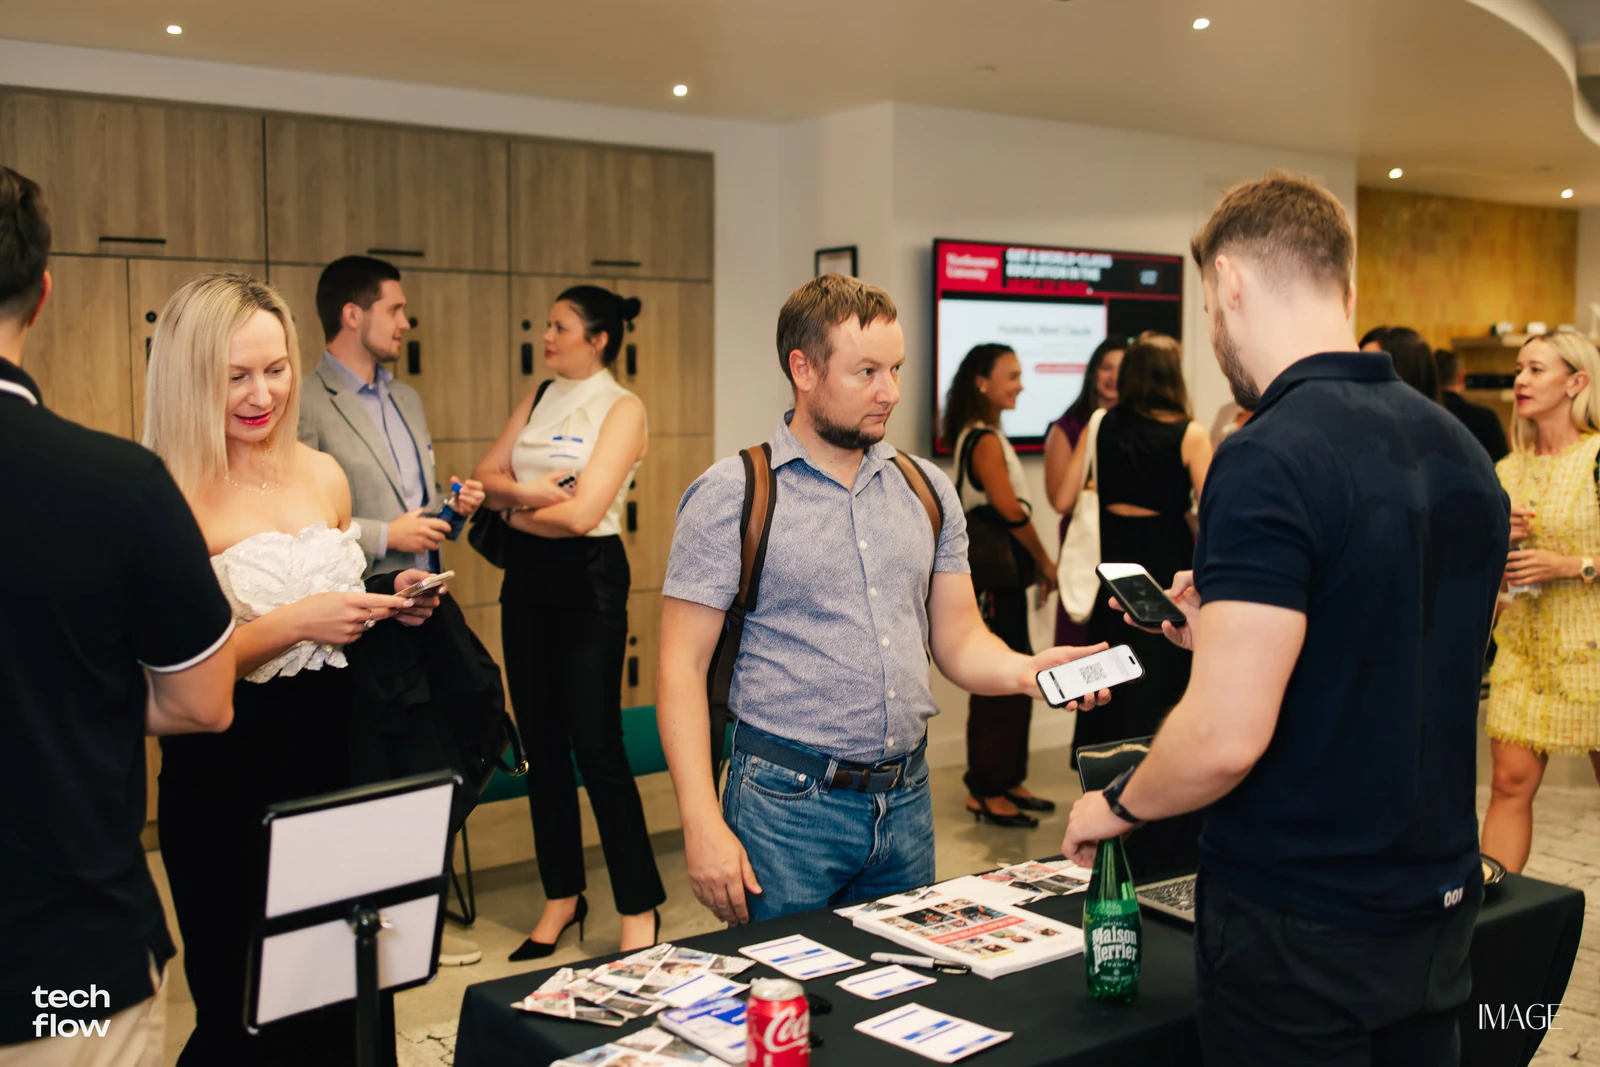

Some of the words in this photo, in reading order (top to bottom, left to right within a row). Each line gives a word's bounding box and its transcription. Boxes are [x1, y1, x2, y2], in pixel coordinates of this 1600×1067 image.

[1443, 886, 1464, 909] 001
[1092, 925, 1137, 946] Maison
[1092, 942, 1137, 974] Perrier
